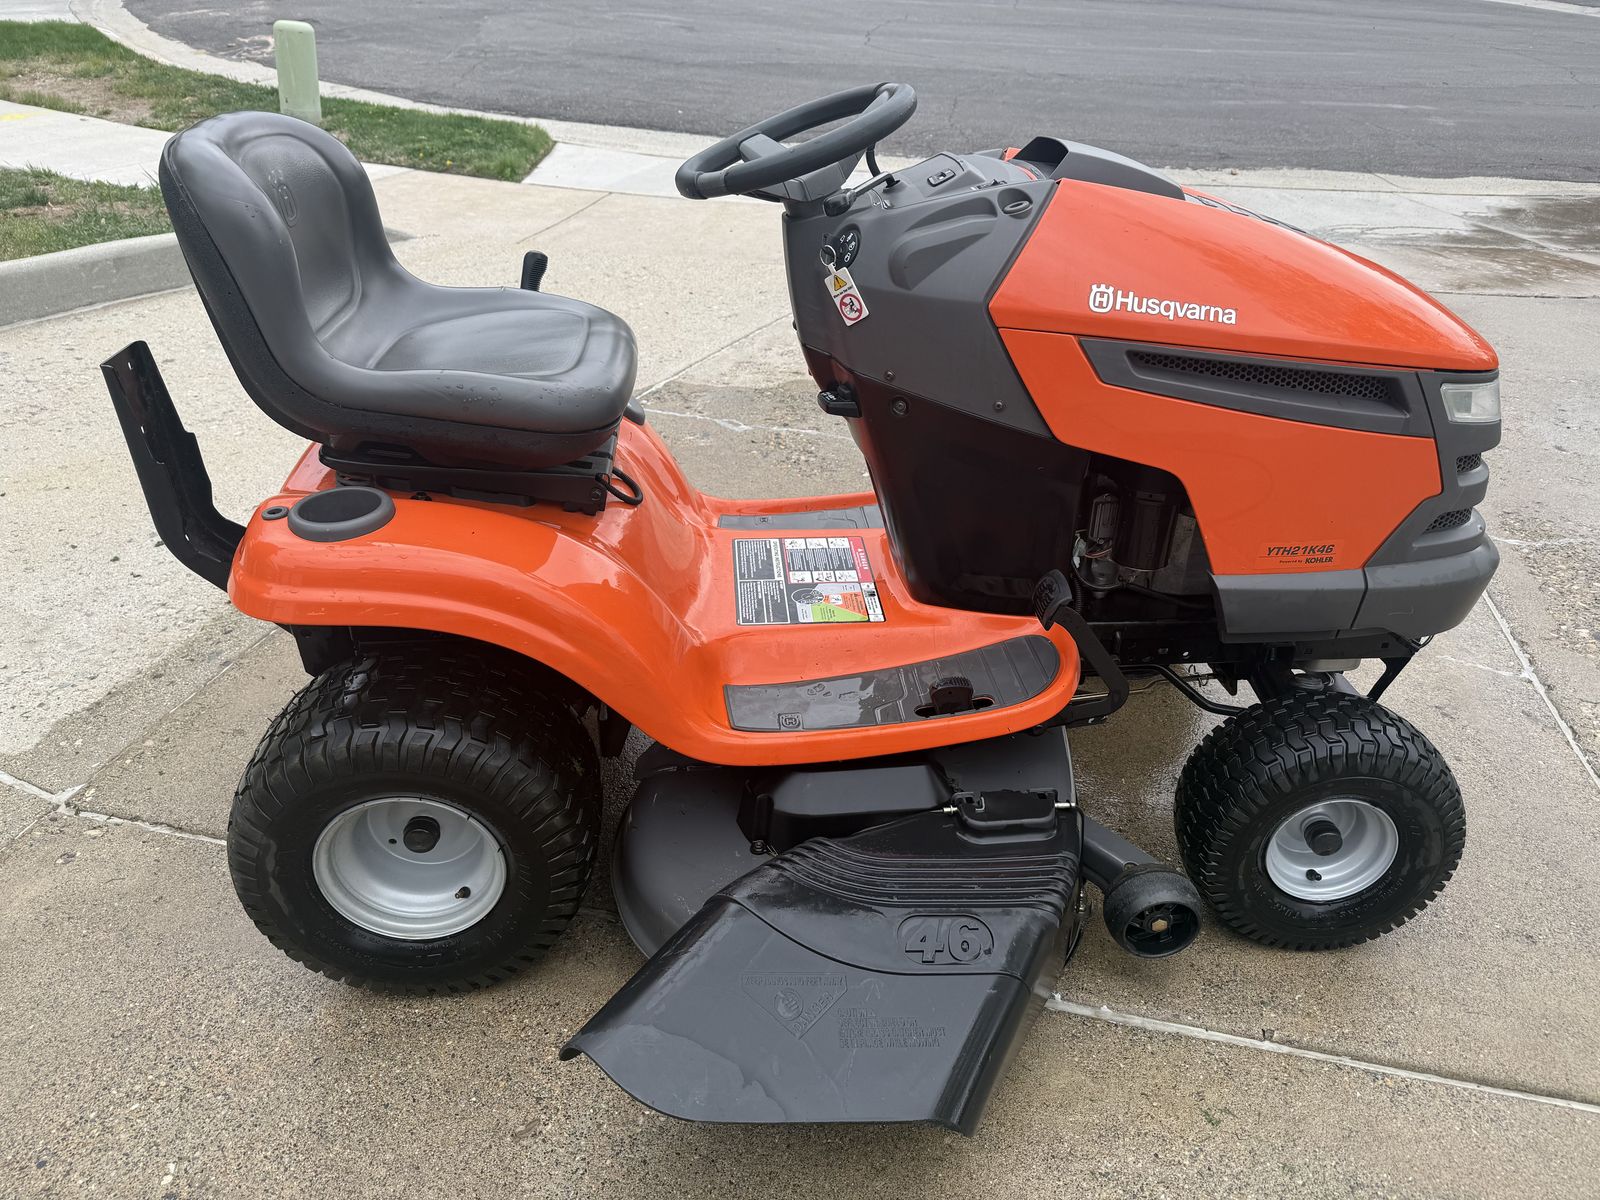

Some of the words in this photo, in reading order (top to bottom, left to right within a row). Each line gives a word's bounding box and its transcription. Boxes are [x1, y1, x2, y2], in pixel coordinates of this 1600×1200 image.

[1115, 289, 1237, 325] Husqvarna
[1267, 544, 1335, 556] YTH21K46
[904, 917, 983, 964] 46
[792, 991, 834, 1033] DANGER
